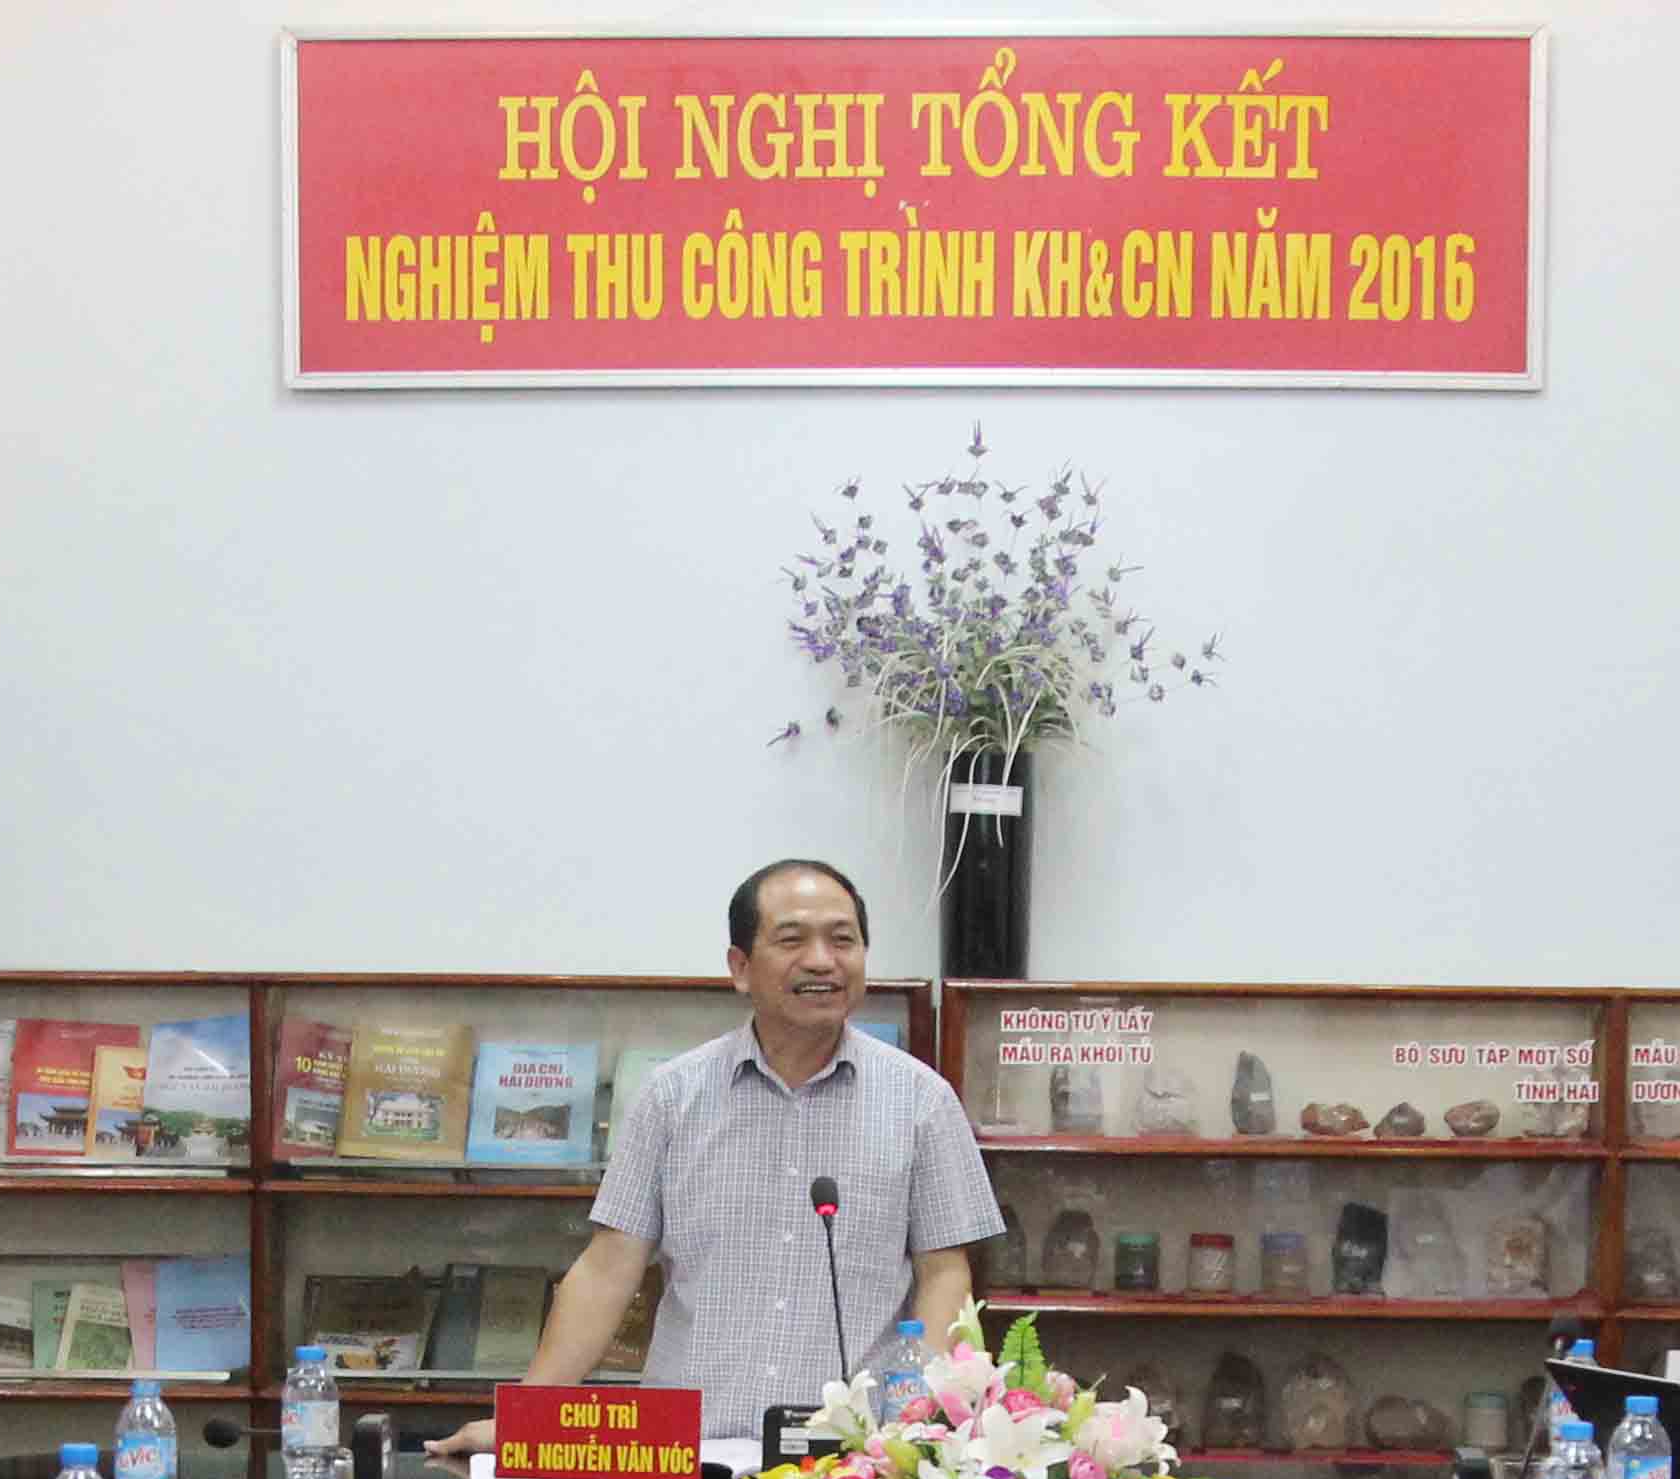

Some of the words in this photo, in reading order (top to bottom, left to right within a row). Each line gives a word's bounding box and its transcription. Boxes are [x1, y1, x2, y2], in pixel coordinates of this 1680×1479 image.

[498, 70, 648, 203] HỘI
[674, 92, 888, 198] NGHỊ
[912, 48, 1144, 178] TỔNG
[1164, 59, 1331, 181] KẾT
[345, 211, 552, 345] NGHIỆM
[566, 231, 667, 322] THU
[681, 209, 826, 322] CÔNG
[838, 203, 999, 321] TRÌNH
[1012, 229, 1197, 321] KH&CN
[1210, 208, 1336, 322] NĂM
[1347, 232, 1479, 322] 2016
[1002, 1008, 1066, 1031] KHÔNG
[1118, 1006, 1152, 1031] LẤY
[1050, 1046, 1074, 1063] RA
[1395, 1041, 1419, 1069] BỘ
[1429, 1045, 1466, 1065] SƯU
[1475, 1042, 1510, 1069] TẬP
[1566, 1075, 1600, 1100] HẢI
[559, 1393, 601, 1429] CHỦ
[606, 1400, 640, 1429] TRÌ
[501, 1441, 533, 1470] CN.
[617, 1440, 654, 1473] VĂN
